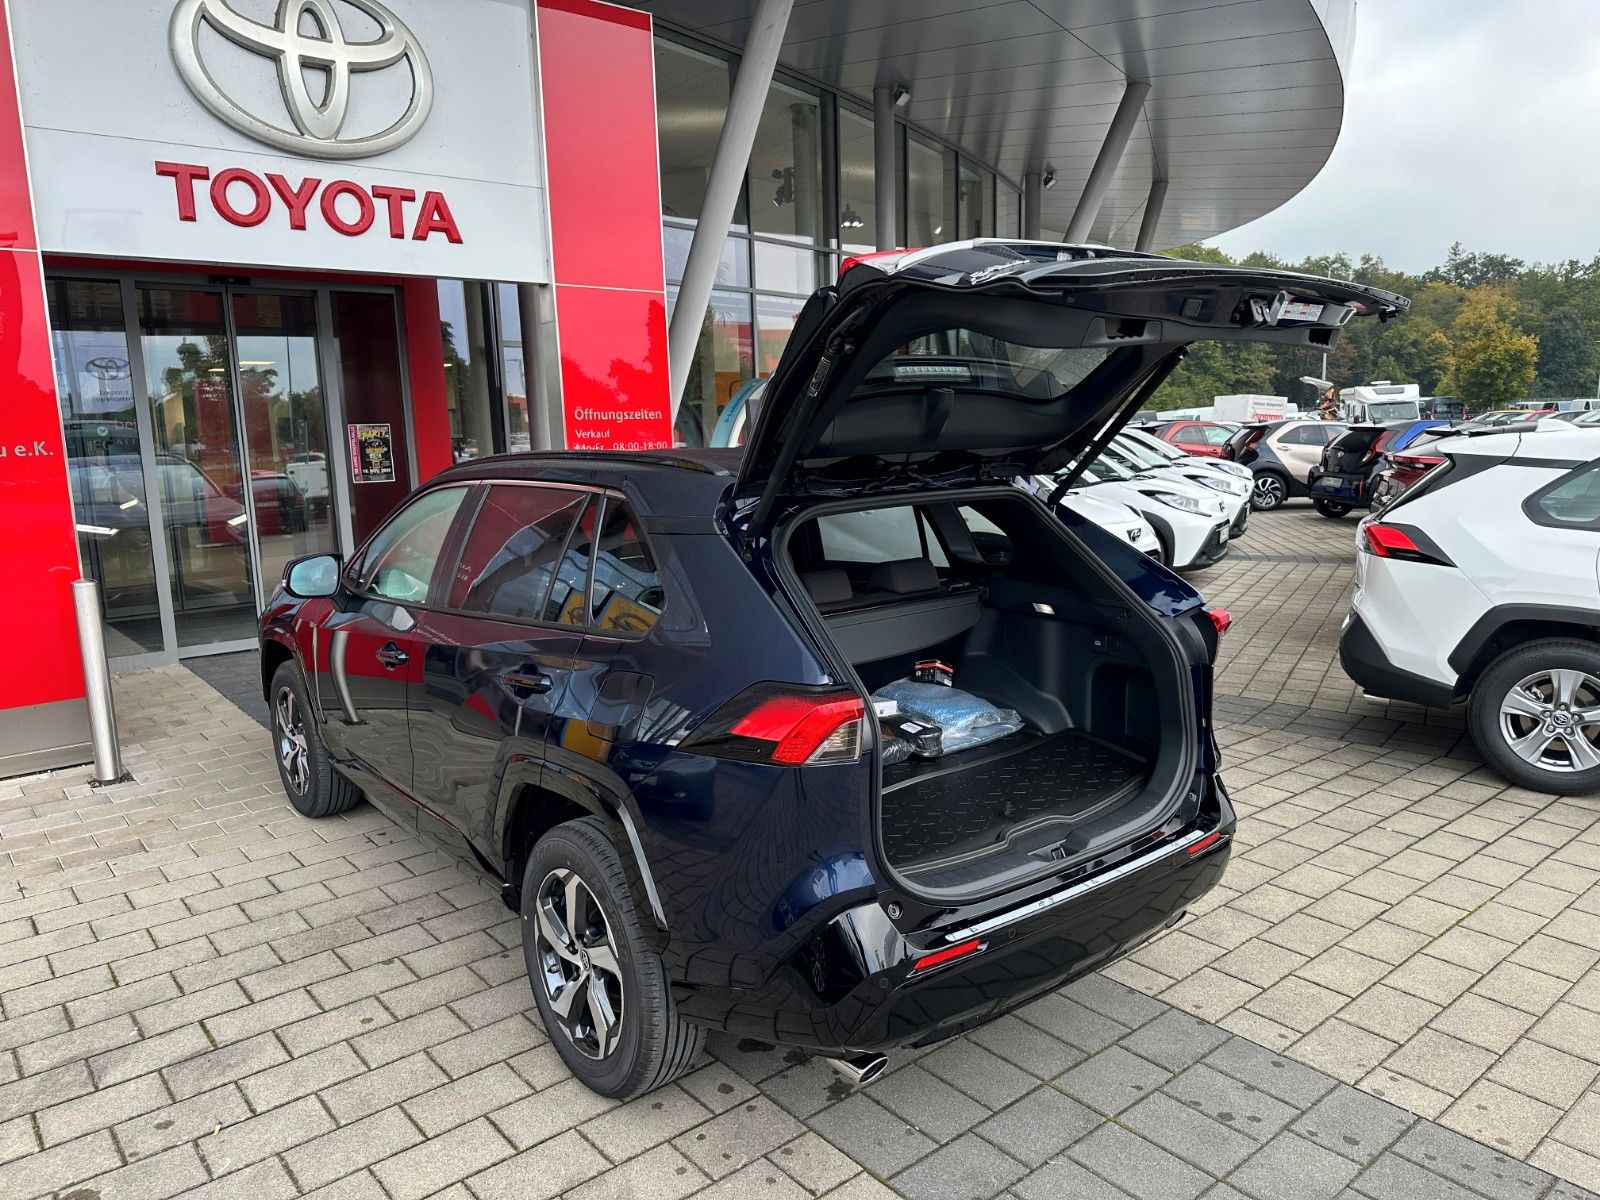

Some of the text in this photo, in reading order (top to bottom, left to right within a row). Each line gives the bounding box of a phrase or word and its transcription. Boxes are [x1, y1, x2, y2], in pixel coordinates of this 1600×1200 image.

[154, 160, 464, 244] TOYOTA
[574, 406, 662, 423] Öffnungszeiten
[575, 429, 610, 439] Verkauf
[14, 441, 54, 457] e.K.
[613, 441, 668, 451] 08:00-18:00
